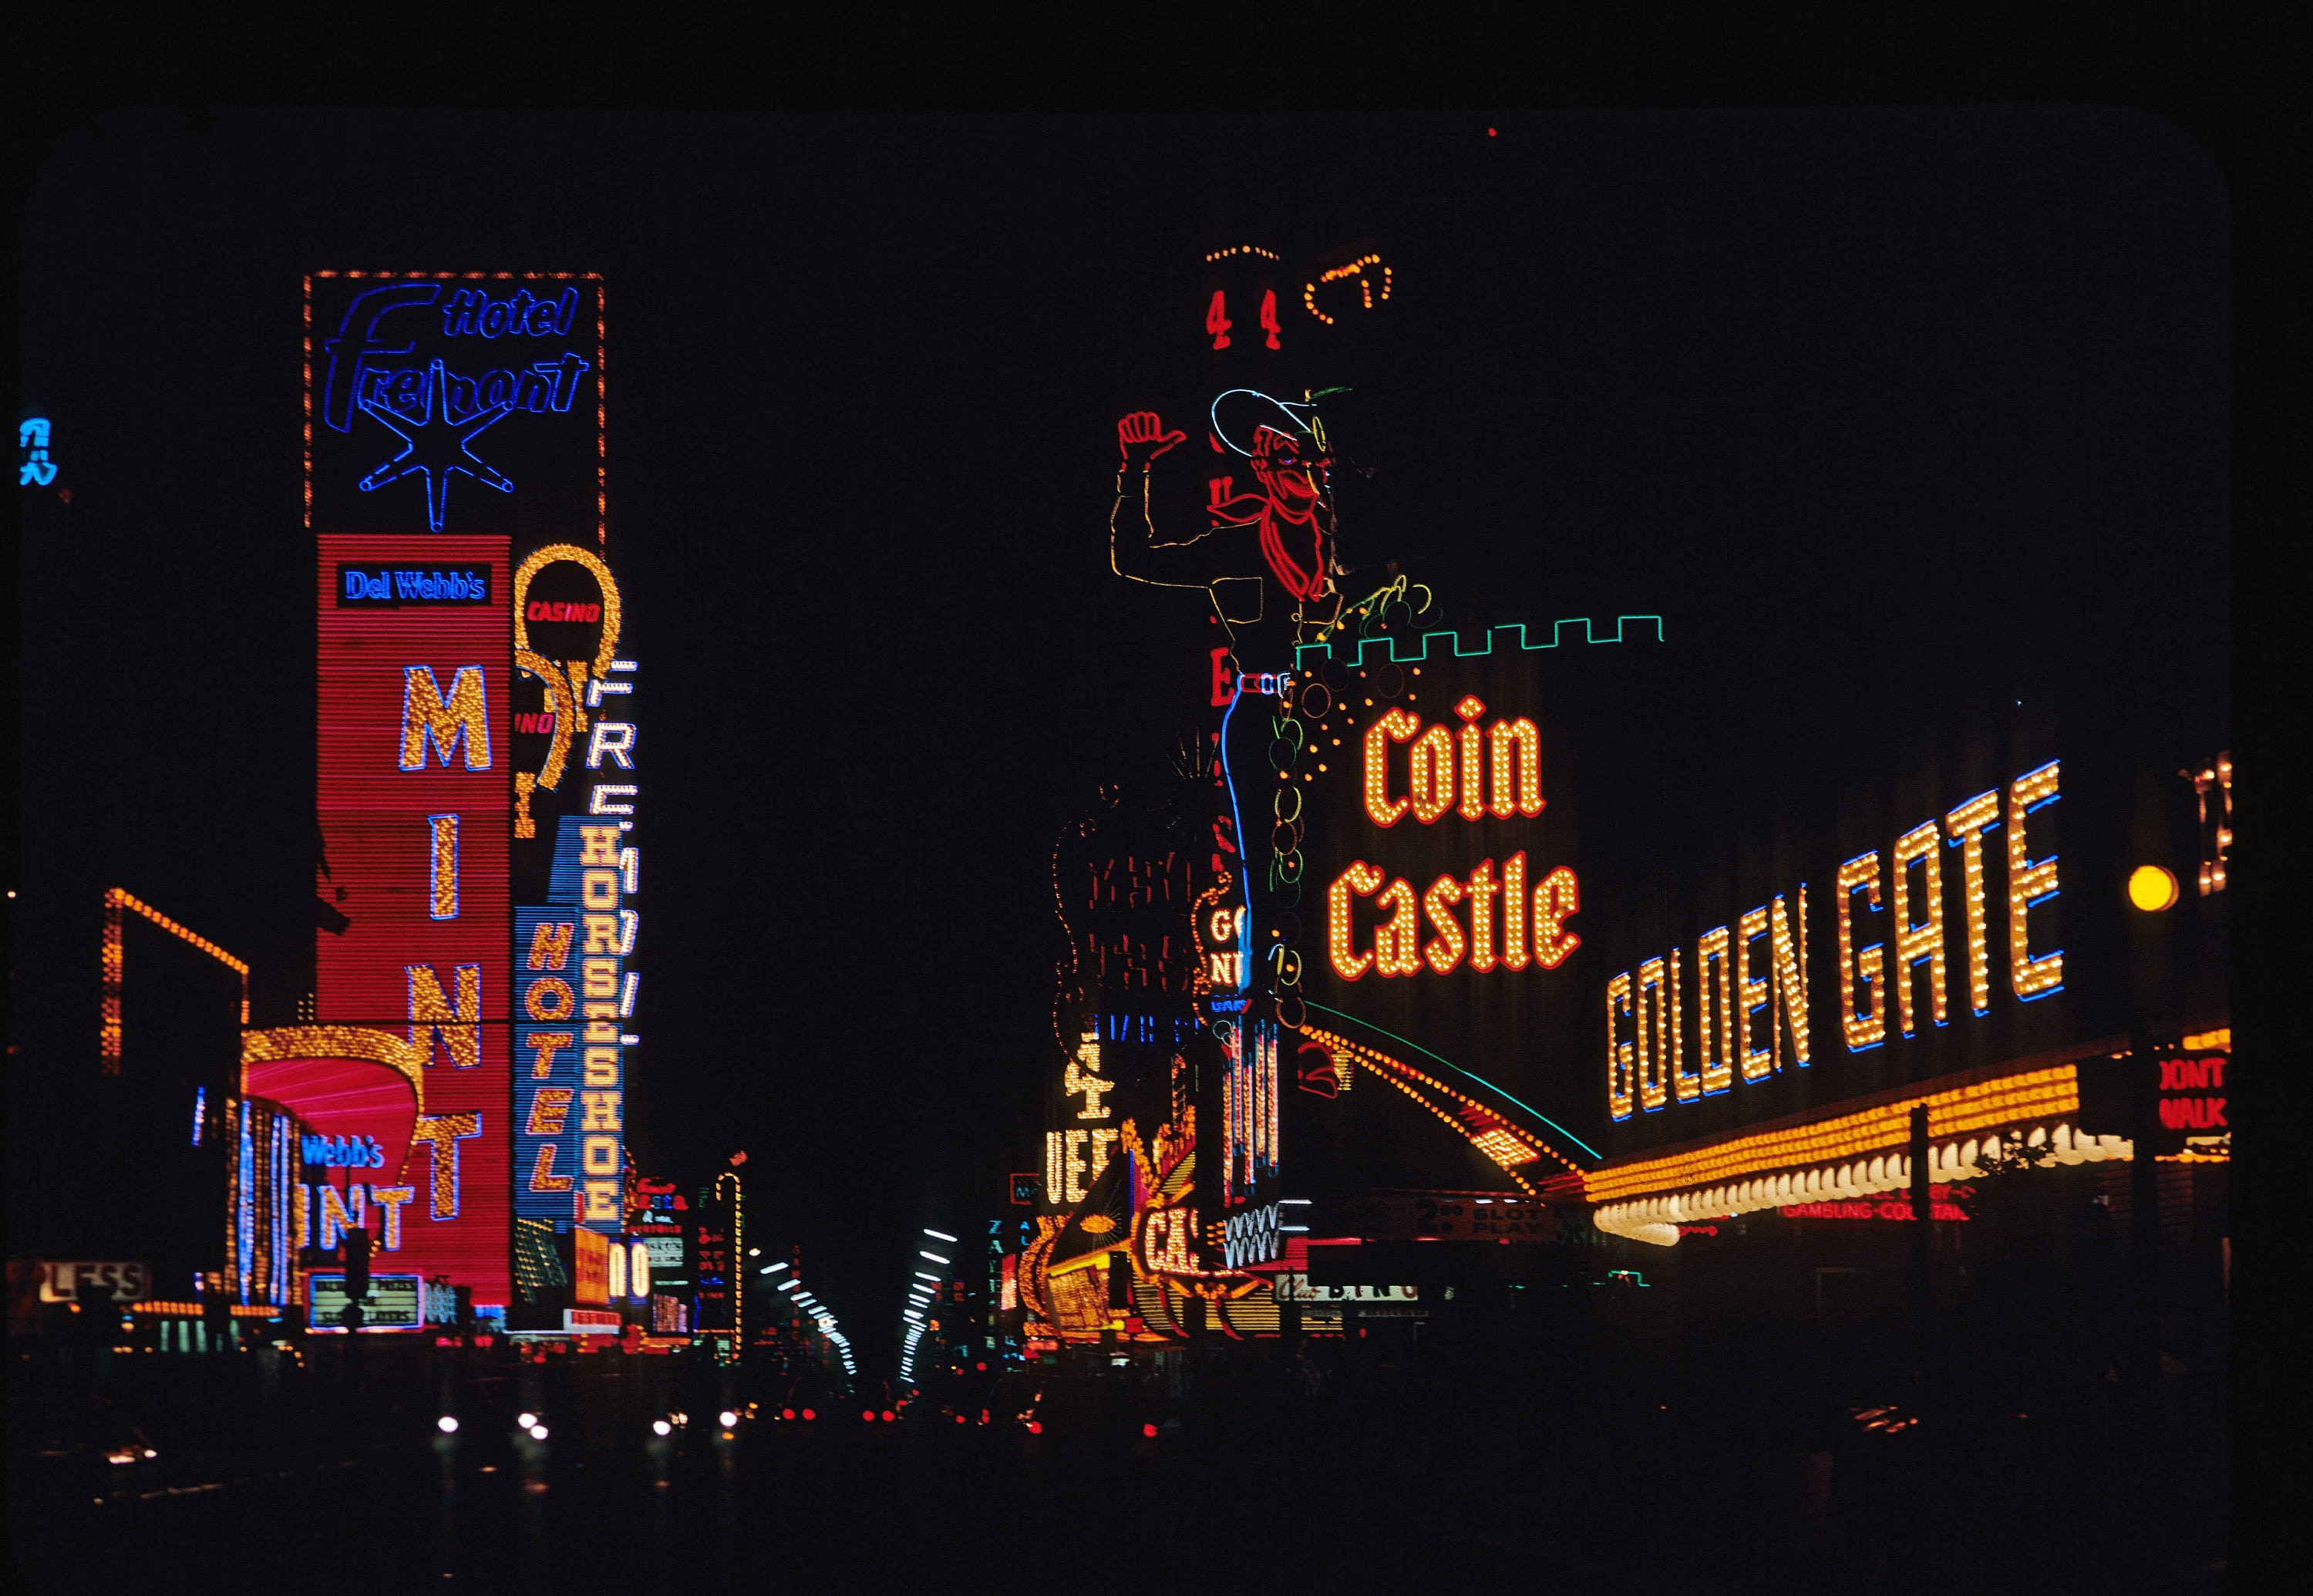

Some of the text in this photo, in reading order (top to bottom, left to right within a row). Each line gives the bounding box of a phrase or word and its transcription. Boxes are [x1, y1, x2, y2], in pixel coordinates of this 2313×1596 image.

[324, 282, 591, 433] Fremont
[443, 285, 579, 338] Hotel
[345, 570, 487, 601] Del Webb's
[527, 594, 601, 623] CASINO
[1364, 694, 1547, 827] Coin
[398, 665, 493, 1221] MINT
[1328, 850, 1582, 982] Castle
[1606, 881, 1812, 1124] GOLDEN
[1836, 758, 2066, 1055] GATE
[524, 921, 574, 1193] HOTEL
[580, 825, 626, 1221] HORSESHOE
[2159, 1097, 2228, 1130] WALK
[1472, 1222, 1544, 1234] PLAY
[1473, 1208, 1542, 1221] SLOT
